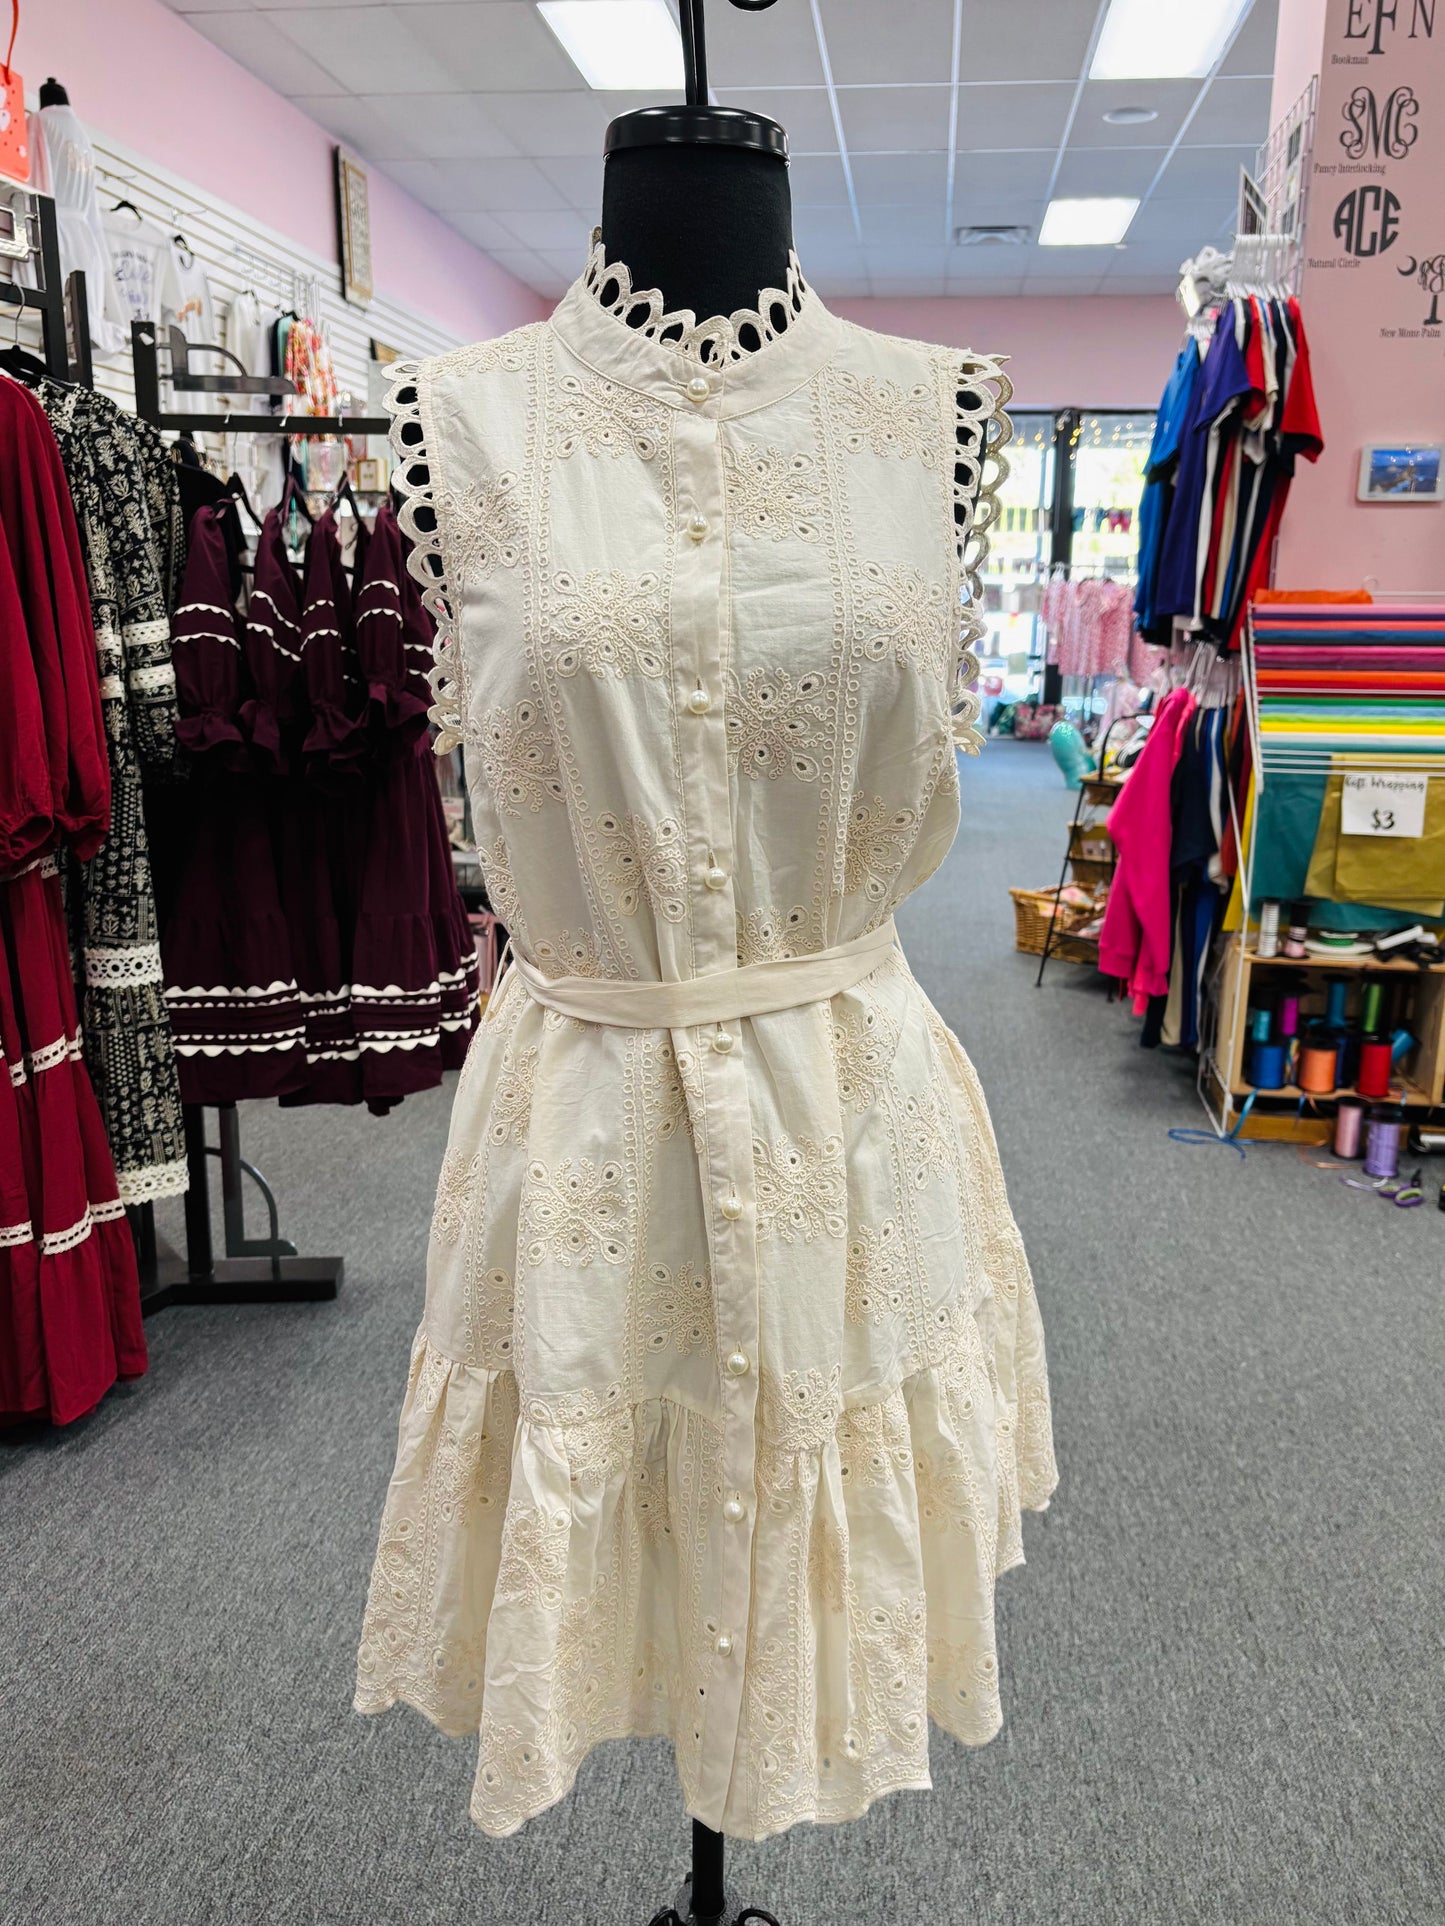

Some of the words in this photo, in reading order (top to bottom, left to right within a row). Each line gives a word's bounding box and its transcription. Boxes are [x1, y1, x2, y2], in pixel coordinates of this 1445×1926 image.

[1331, 54, 1369, 65] Bookman
[1314, 163, 1336, 176] Fancy
[1333, 185, 1401, 257] ACE
[1307, 258, 1336, 269] Natural
[1371, 809, 1395, 830] $3
